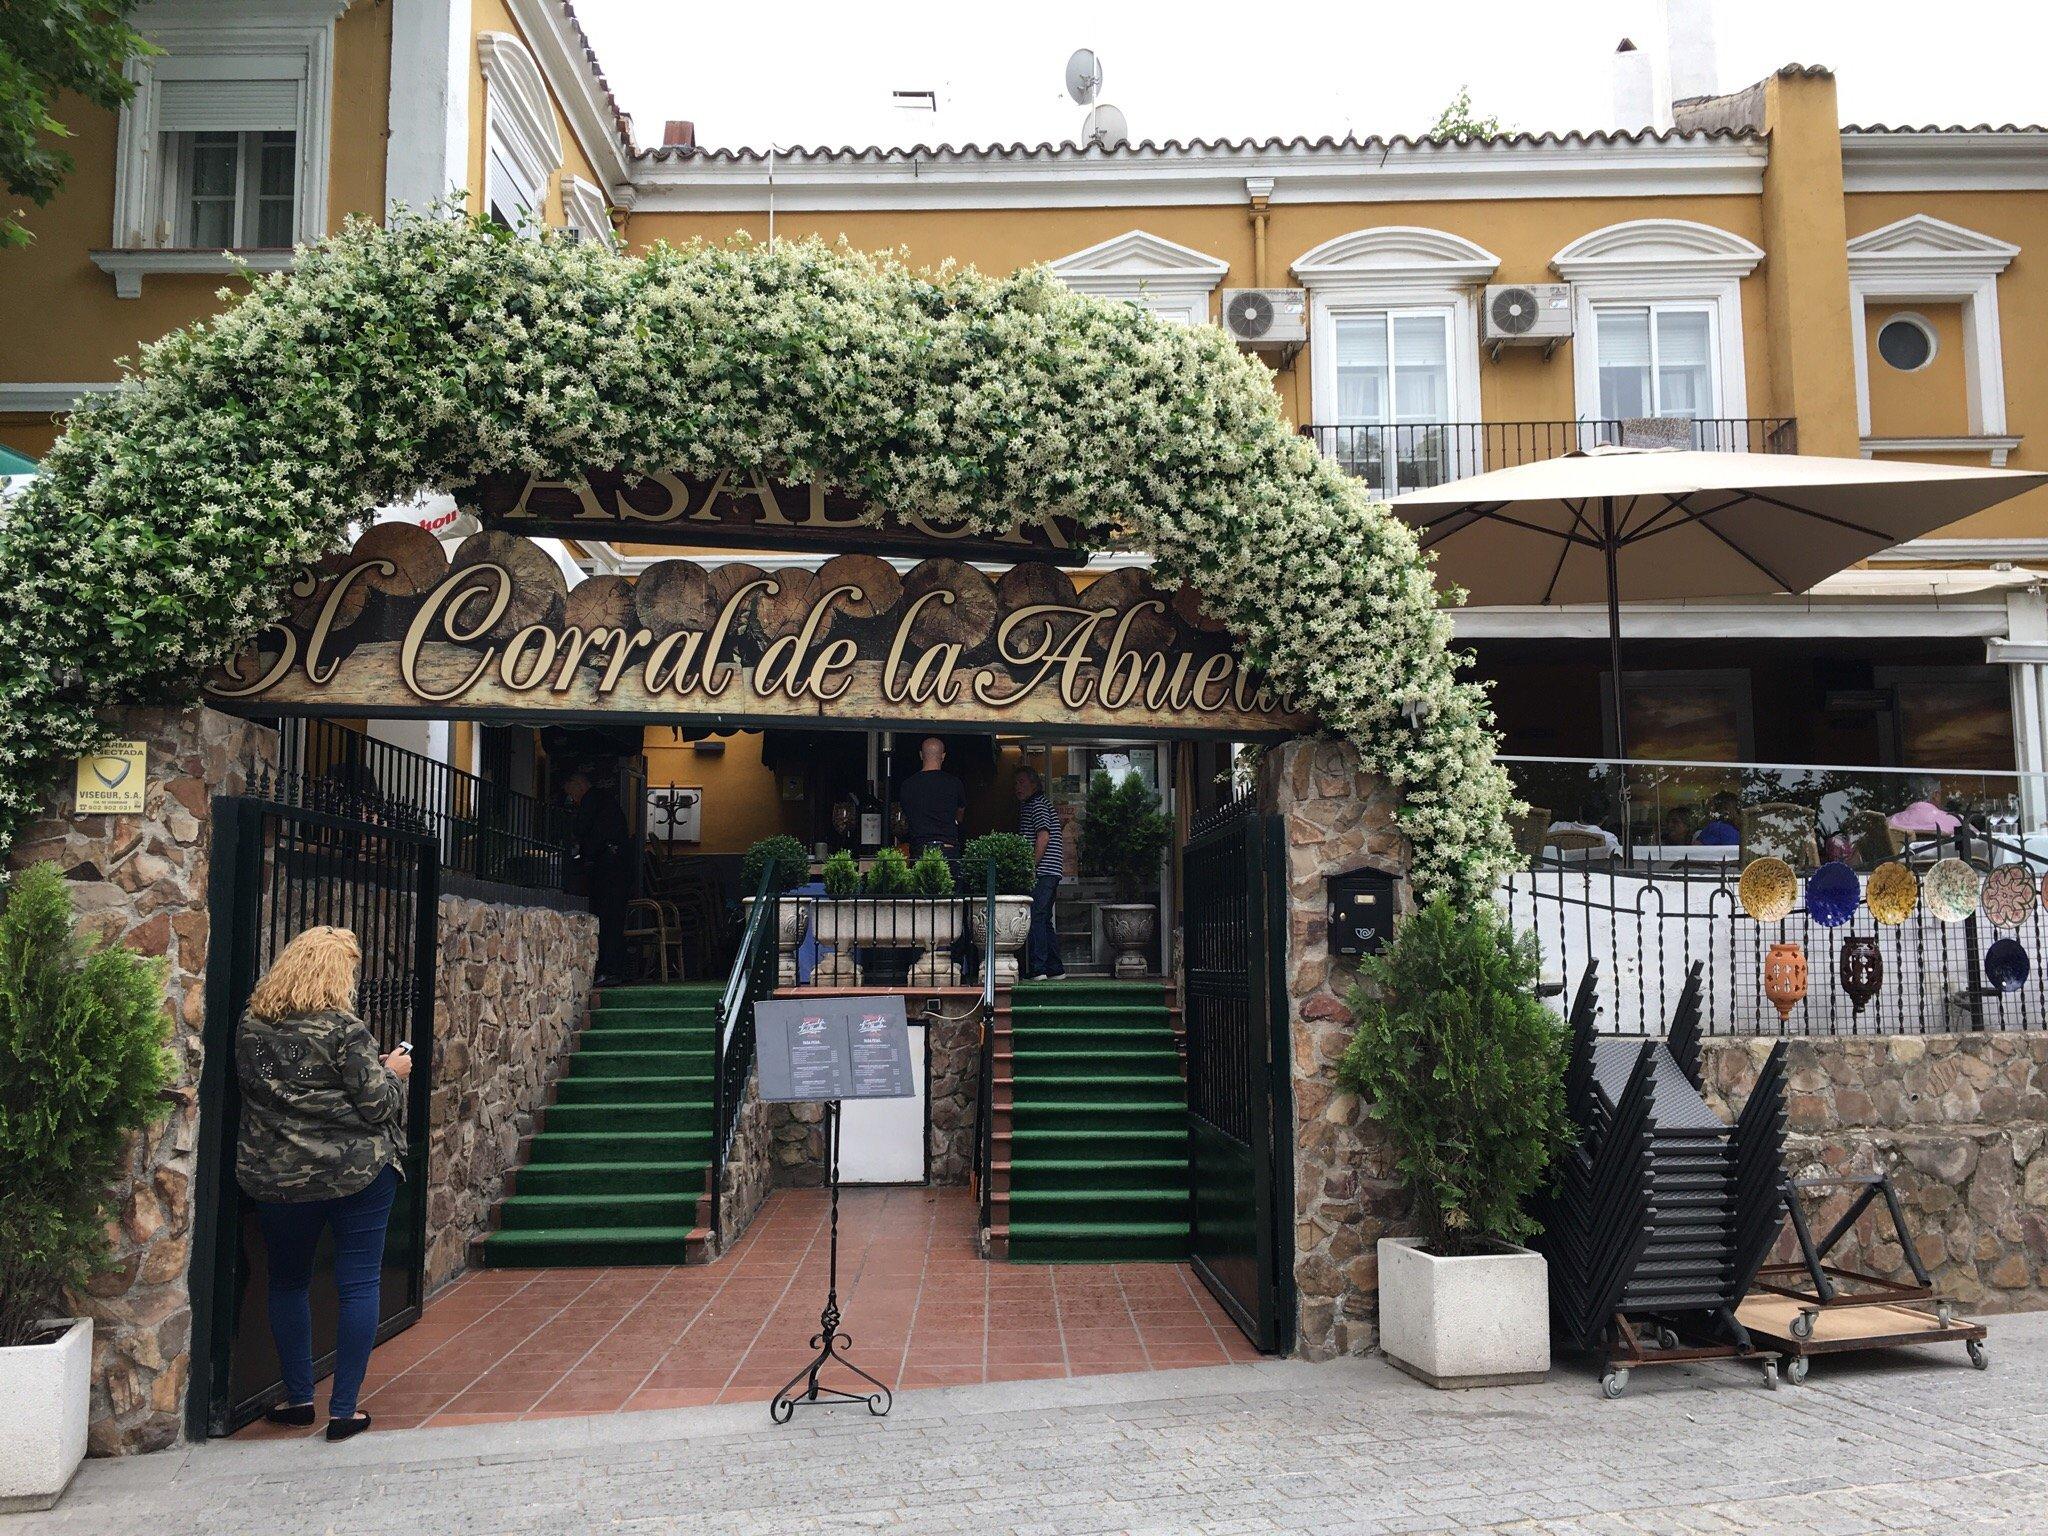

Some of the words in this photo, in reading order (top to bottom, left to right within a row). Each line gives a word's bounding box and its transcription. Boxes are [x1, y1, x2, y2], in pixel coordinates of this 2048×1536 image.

[401, 563, 779, 701] Corral
[754, 586, 861, 699] de
[884, 590, 963, 704] la
